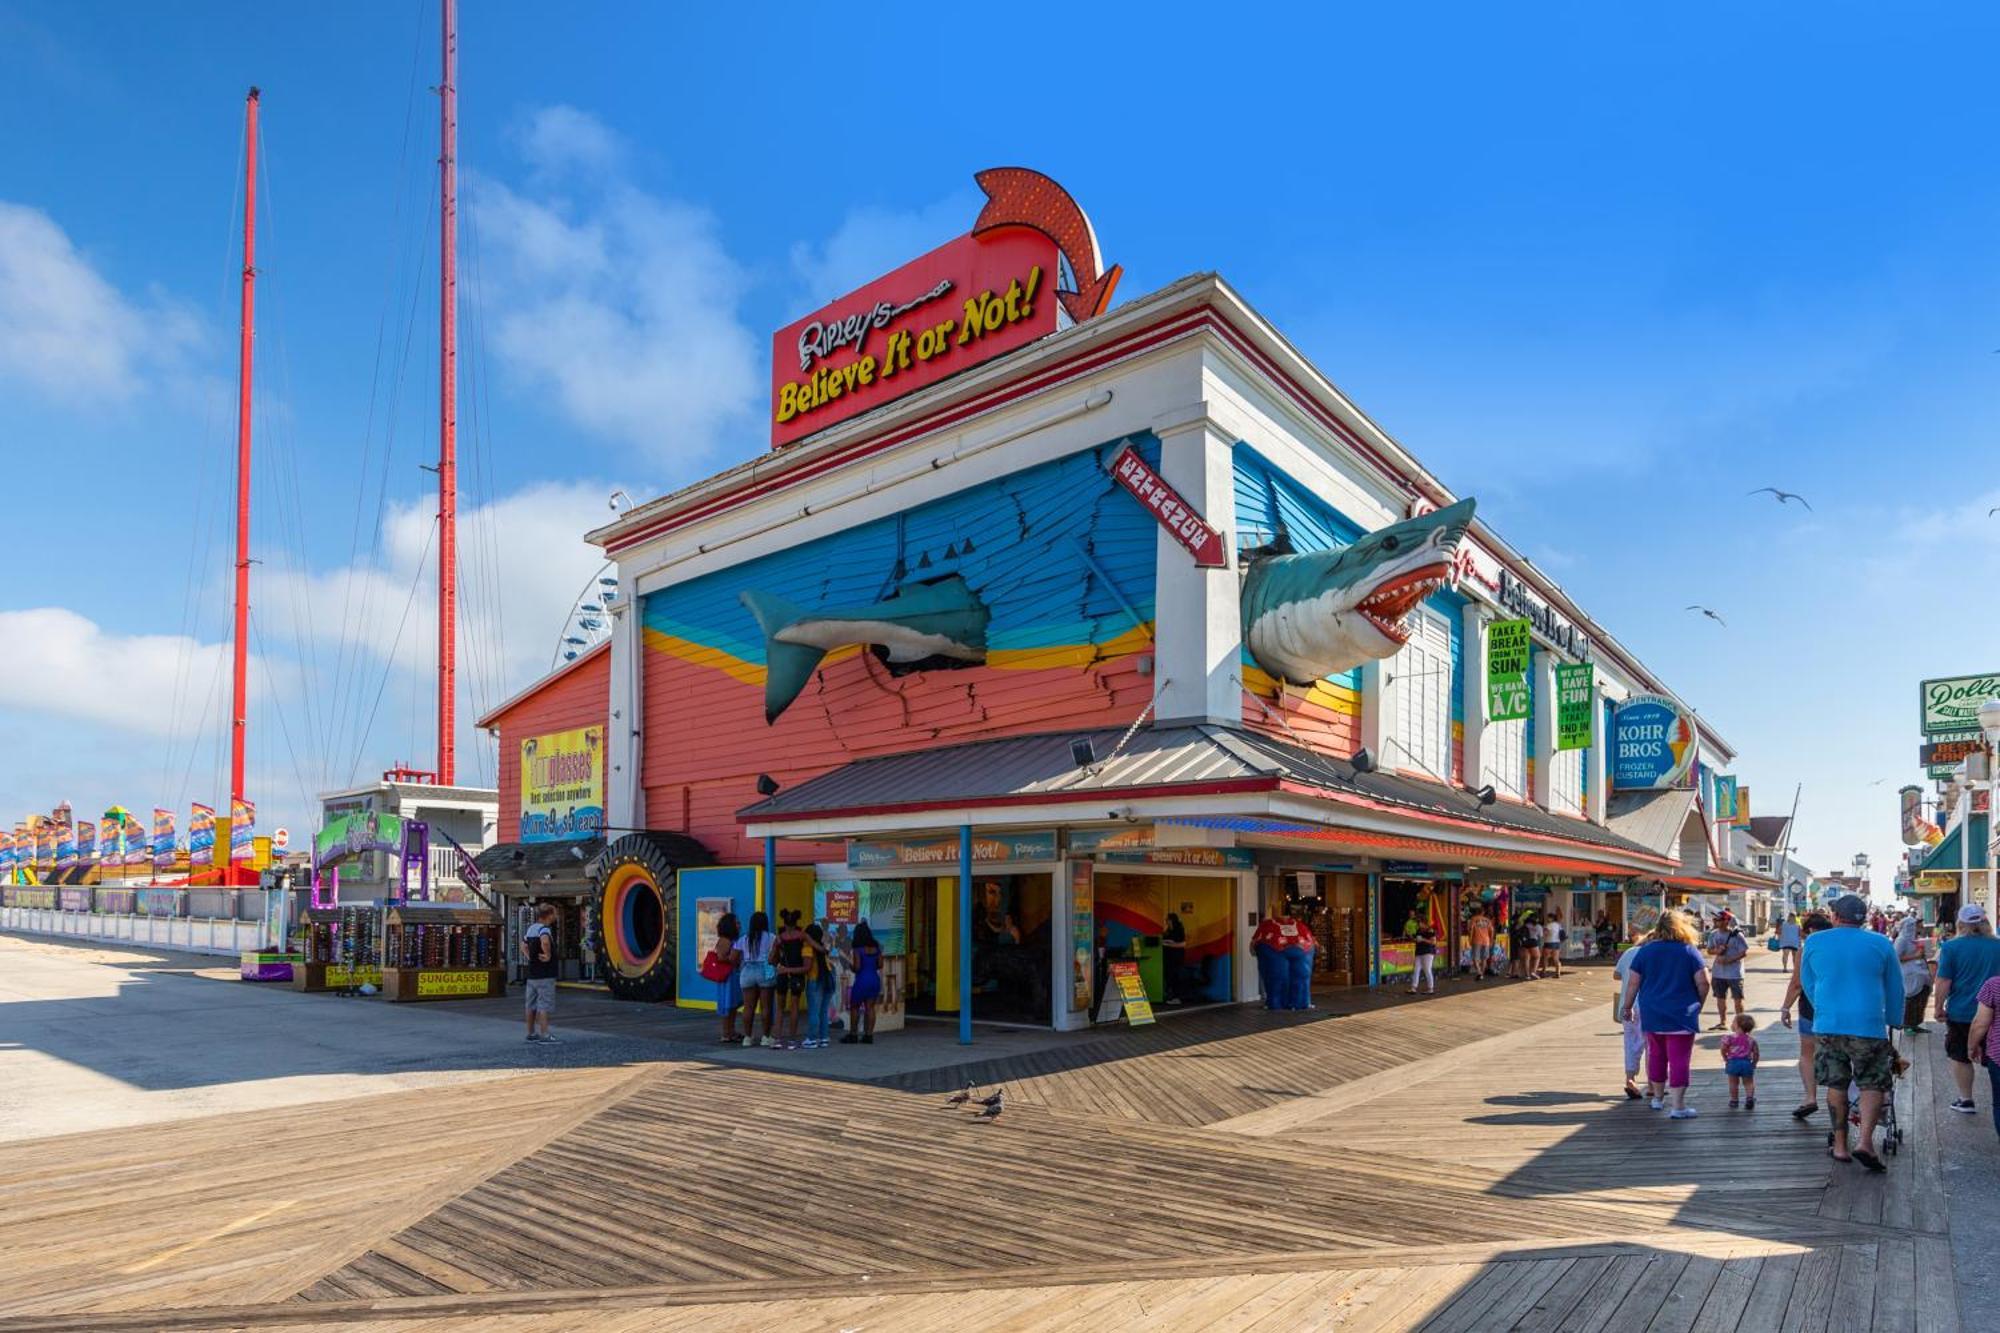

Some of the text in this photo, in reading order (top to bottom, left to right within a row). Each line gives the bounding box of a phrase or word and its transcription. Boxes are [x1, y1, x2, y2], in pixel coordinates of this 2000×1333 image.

[776, 266, 1041, 423] Believe It or Not!
[1119, 457, 1209, 550] ENTRANCE
[1491, 623, 1527, 638] TAKE A
[1491, 635, 1527, 650] BREAK
[1491, 647, 1526, 659] FROM THE
[1491, 657, 1526, 676] SUN.
[1560, 667, 1592, 678] WE ONLY
[1491, 683, 1504, 693] WE
[1562, 676, 1589, 689] HAVE
[1562, 688, 1589, 704] FUN
[1492, 692, 1527, 717] A/C
[1560, 721, 1589, 734] END IN
[1617, 724, 1664, 741] KOHR
[1935, 733, 1977, 743] TAFFY
[1619, 741, 1662, 758] BROS
[1932, 751, 1965, 763] CAN
[1619, 762, 1654, 771] FROZEN
[1616, 770, 1657, 780] CUSTARD
[523, 810, 530, 834] 2
[904, 847, 943, 863] Believe
[945, 845, 958, 862] It
[972, 841, 1000, 861] Not!
[1546, 874, 1572, 885] ATM
[419, 973, 488, 984] SUNGLASSES
[418, 985, 425, 994] 2
